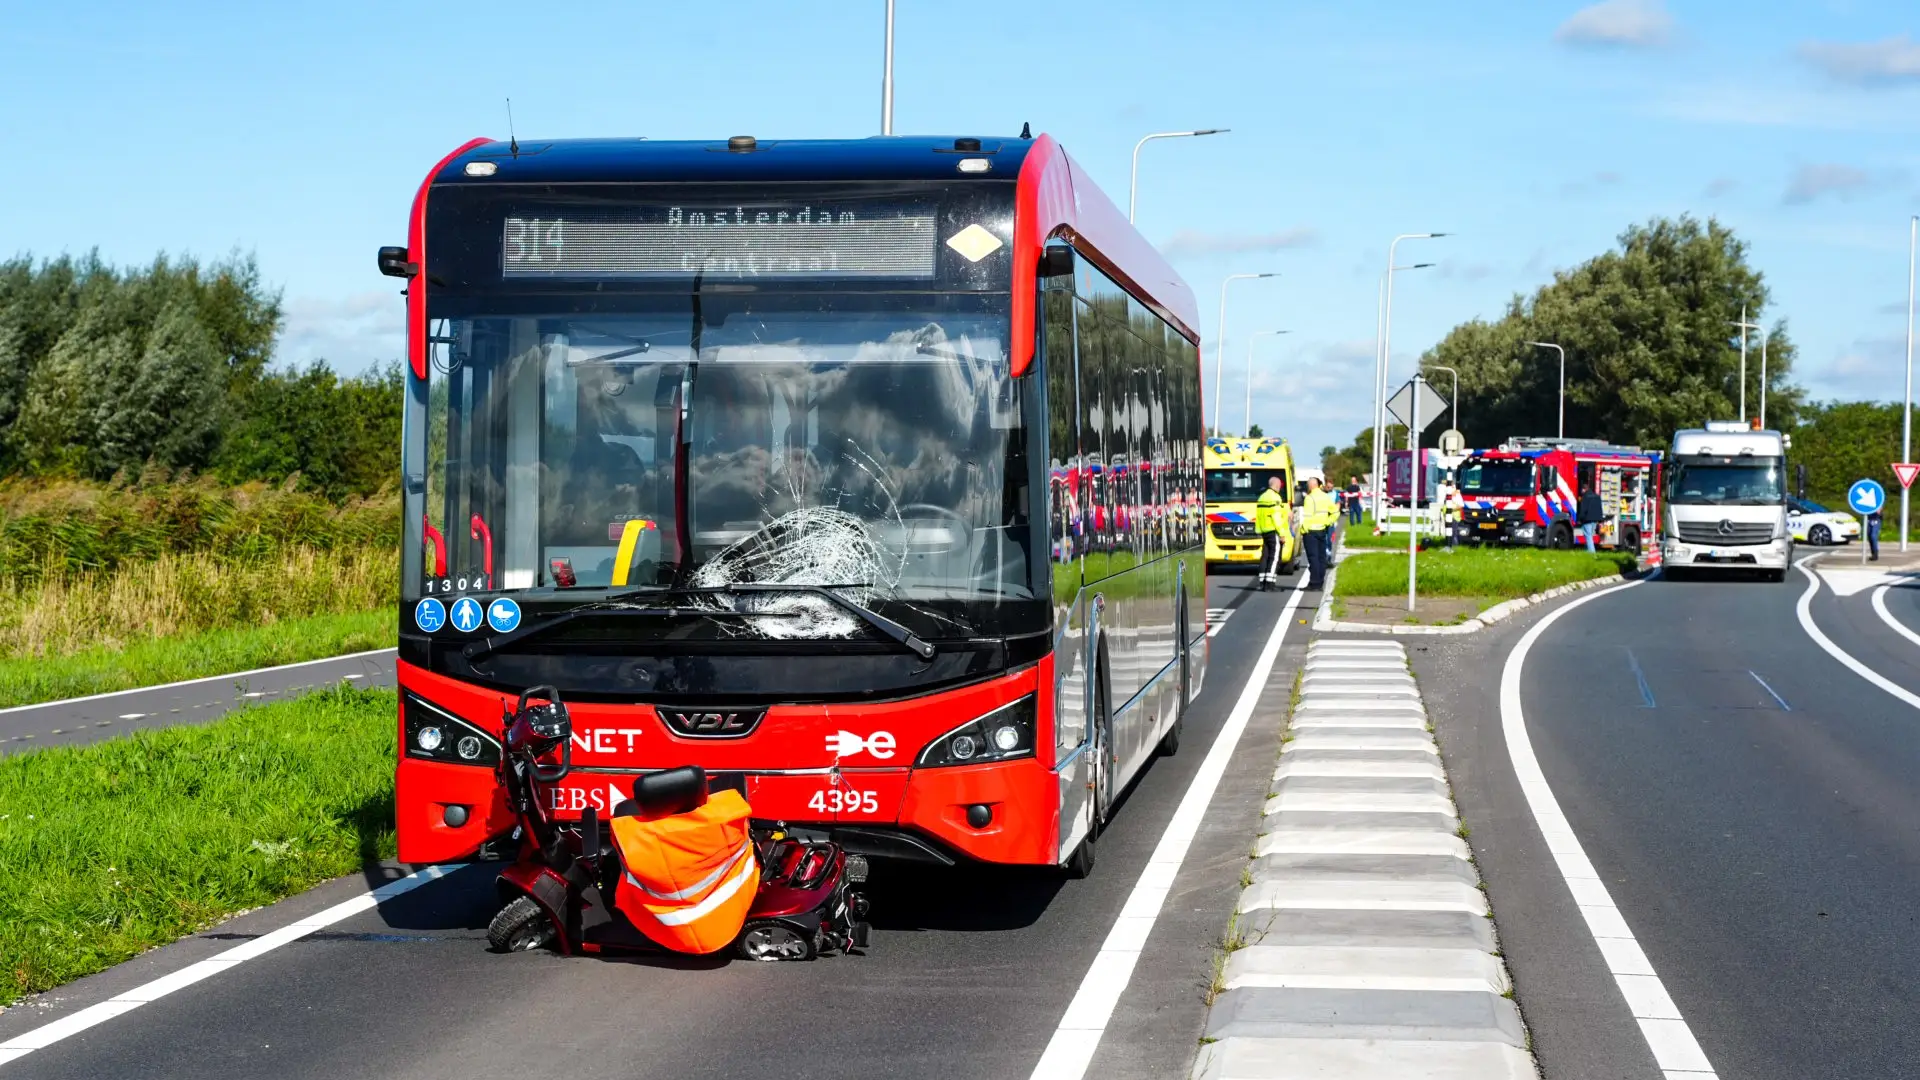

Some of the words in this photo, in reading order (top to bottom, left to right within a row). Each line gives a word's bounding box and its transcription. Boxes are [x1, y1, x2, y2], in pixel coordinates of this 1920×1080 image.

[668, 206, 855, 226] Amsterdam
[507, 218, 564, 261] 314
[681, 251, 838, 272] Centraal
[426, 577, 483, 593] 1304
[676, 713, 744, 729] VDL
[570, 728, 643, 753] NET
[548, 787, 605, 812] EBS
[808, 789, 878, 813] 4395
